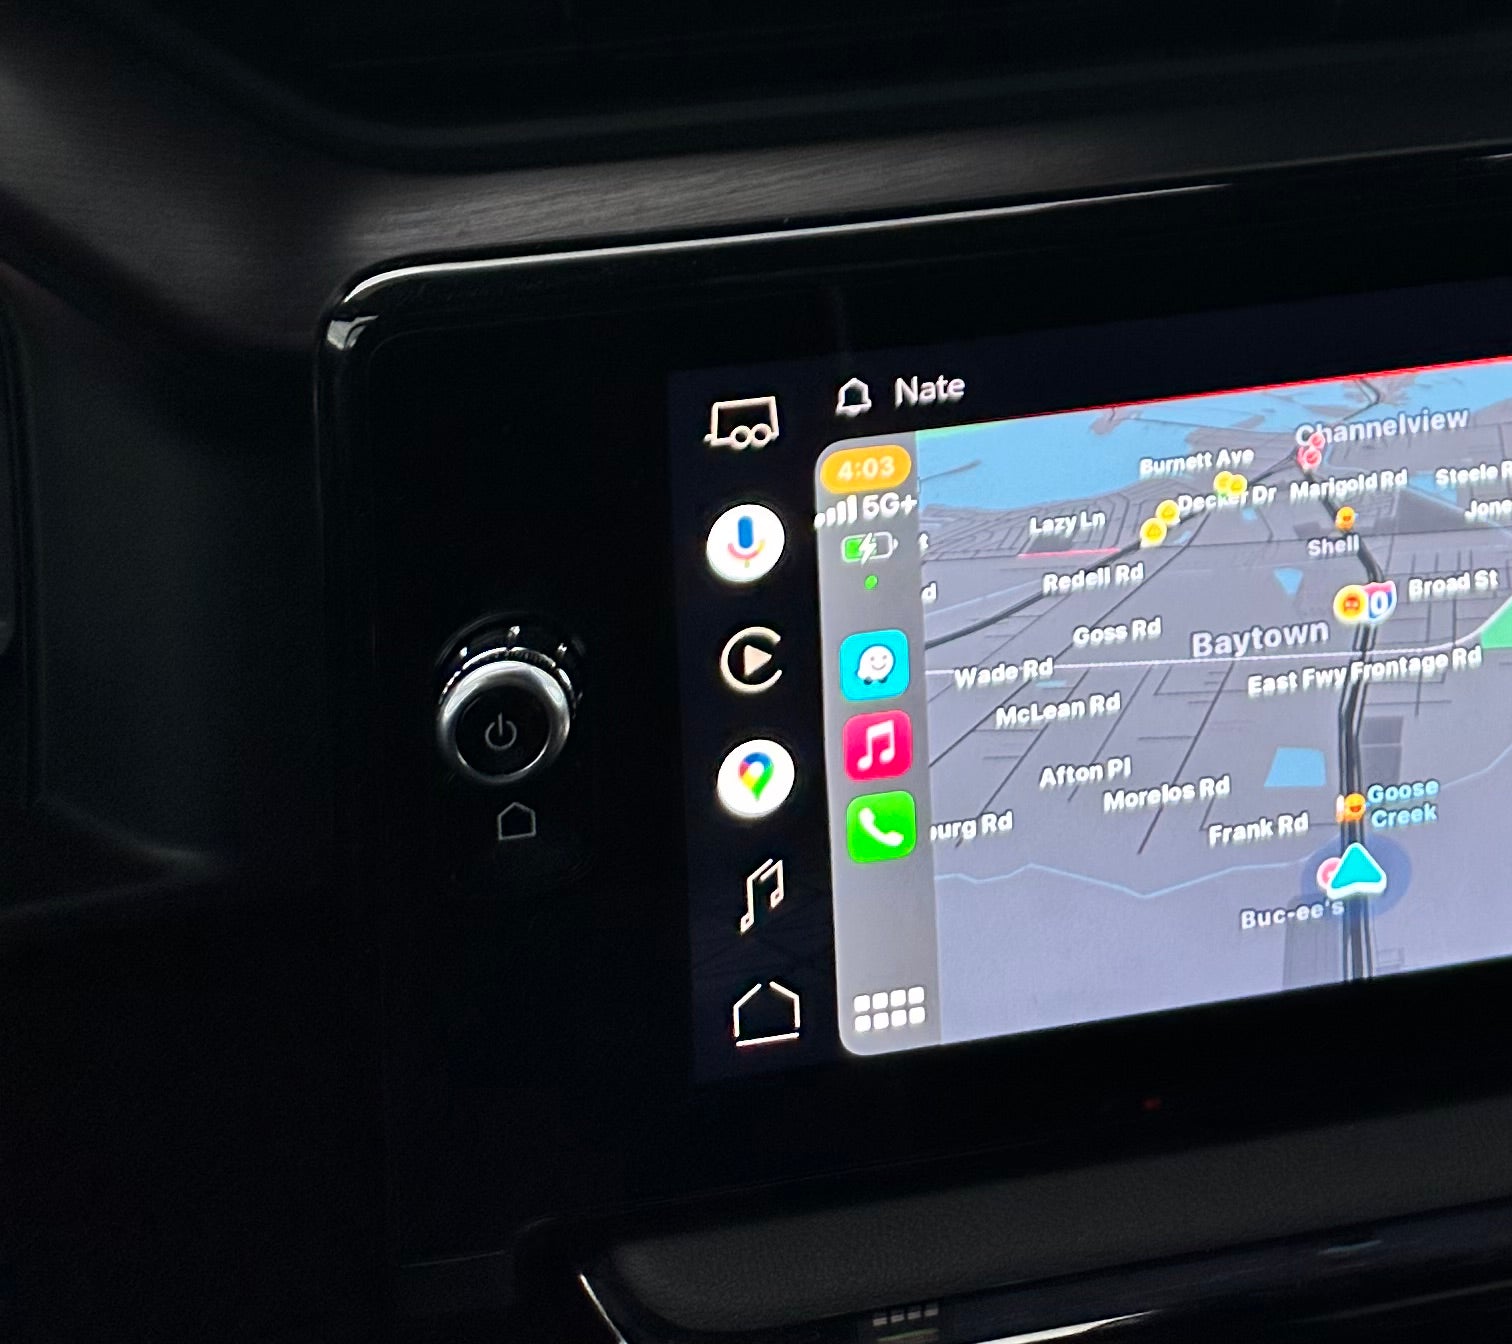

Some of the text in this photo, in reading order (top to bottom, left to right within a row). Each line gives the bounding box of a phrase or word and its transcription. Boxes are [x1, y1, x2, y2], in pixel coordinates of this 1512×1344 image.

[895, 374, 966, 406] Nate
[1295, 408, 1469, 446] Channelview
[837, 456, 896, 481] 4:03
[1139, 449, 1254, 478] Burnett Ave
[1435, 463, 1498, 488] Steele
[1252, 485, 1277, 505] Dr
[1289, 468, 1408, 502] Marigold Rd
[862, 492, 917, 520] 5G+
[1029, 509, 1106, 541] Lazy Ln
[1307, 535, 1360, 559] Shell
[1042, 562, 1144, 595] Redell Rd
[1408, 569, 1499, 602] Broad St
[1072, 617, 1162, 648] Goss Rd
[1191, 619, 1329, 658] Baytown
[954, 656, 1053, 688] Wade Rd
[1248, 645, 1482, 697] East Fwy Frontage Rd
[995, 691, 1121, 729] McLean Rd
[1039, 763, 1104, 789] Afton
[1367, 779, 1439, 804] Goose
[1103, 776, 1230, 815] Morelos Rd
[981, 810, 1013, 835] Rd
[1209, 813, 1309, 848] Frank Rd
[1371, 802, 1437, 828] Creek
[1240, 899, 1345, 931] Buc-ee's
